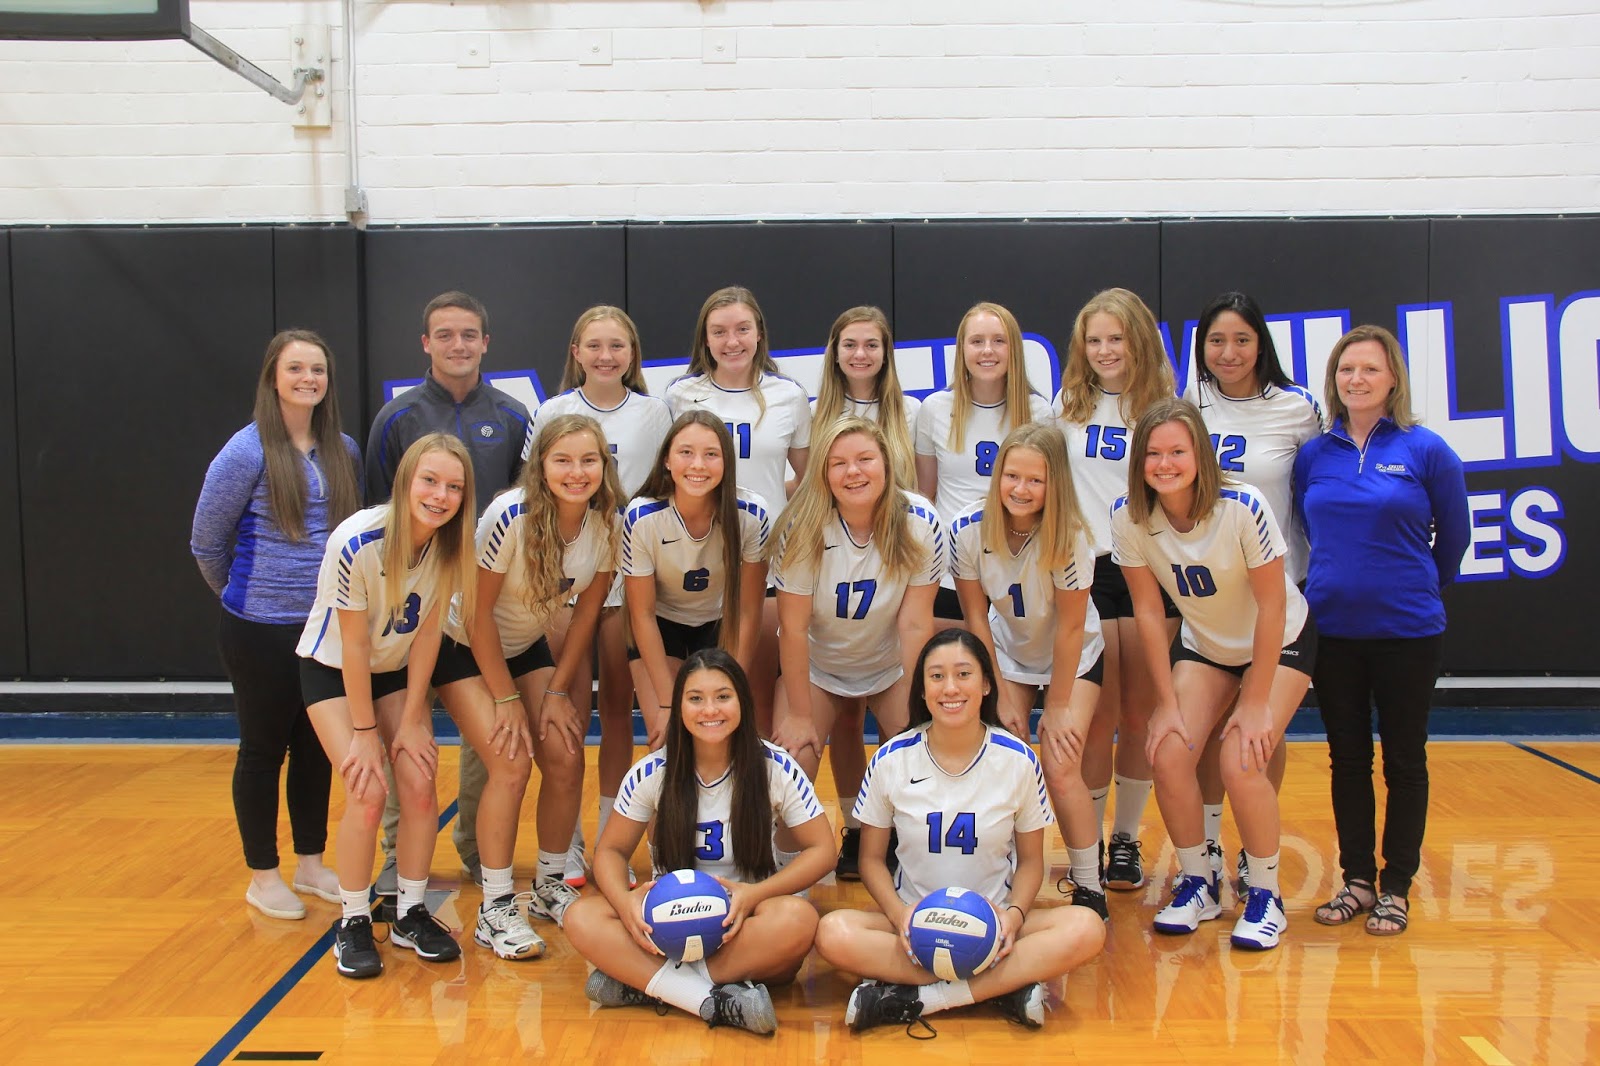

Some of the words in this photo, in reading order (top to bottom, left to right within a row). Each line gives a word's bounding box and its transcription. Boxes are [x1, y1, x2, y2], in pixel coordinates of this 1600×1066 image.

[975, 440, 1000, 477] 8
[1085, 424, 1127, 461] 15
[683, 567, 710, 592] 6
[1170, 563, 1218, 598] 10
[835, 578, 877, 620] 17
[1007, 583, 1026, 618] 1
[694, 819, 724, 861] 3
[926, 811, 978, 855] 14
[669, 901, 712, 917] Baden
[924, 911, 969, 929] Baden
